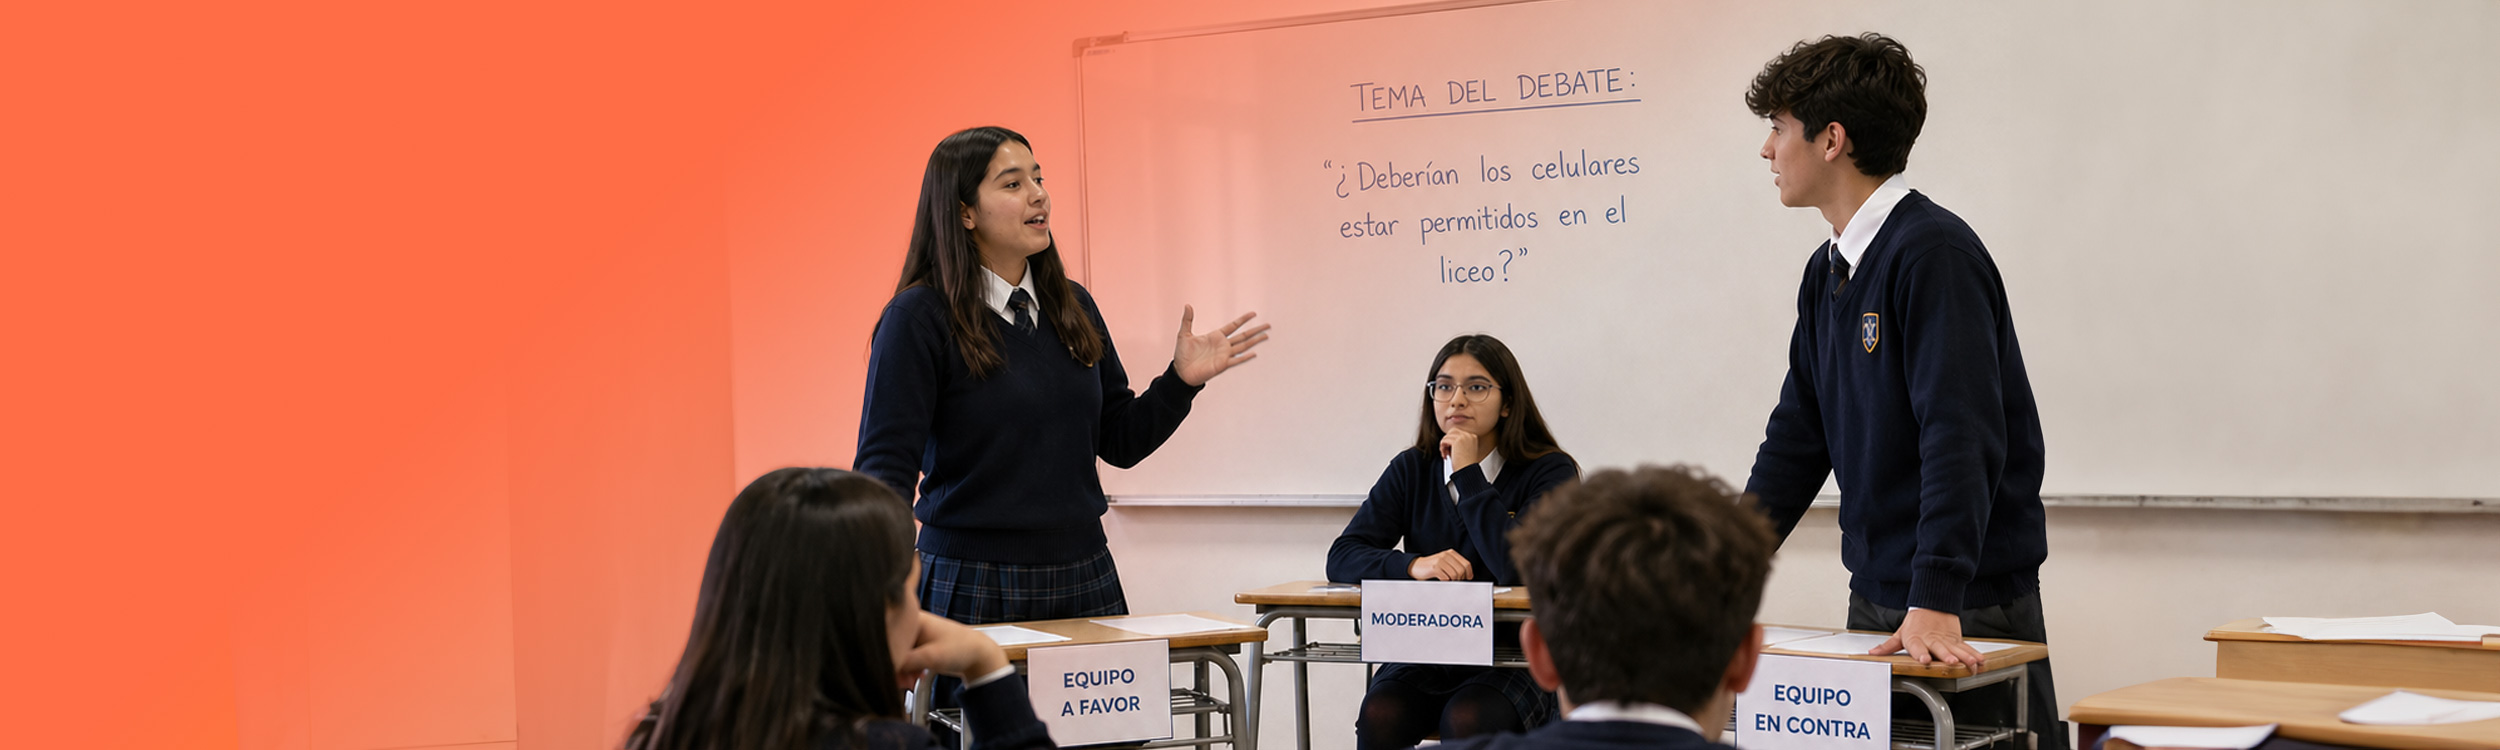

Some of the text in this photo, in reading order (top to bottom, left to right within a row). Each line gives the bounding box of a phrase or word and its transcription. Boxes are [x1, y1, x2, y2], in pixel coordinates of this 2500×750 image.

[1350, 68, 1637, 111] TEMA DEL DEBATE:
[1481, 155, 1511, 182] los
[1532, 149, 1640, 180] celulares
[1340, 195, 1625, 245] estar permitidos en el
[1372, 612, 1484, 628] MODERADORA
[1064, 668, 1135, 689] EQUIPO
[1061, 696, 1140, 717] A FAVOR
[1774, 684, 1851, 706] EQUIPO
[1755, 713, 1871, 740] EN CONTRA
